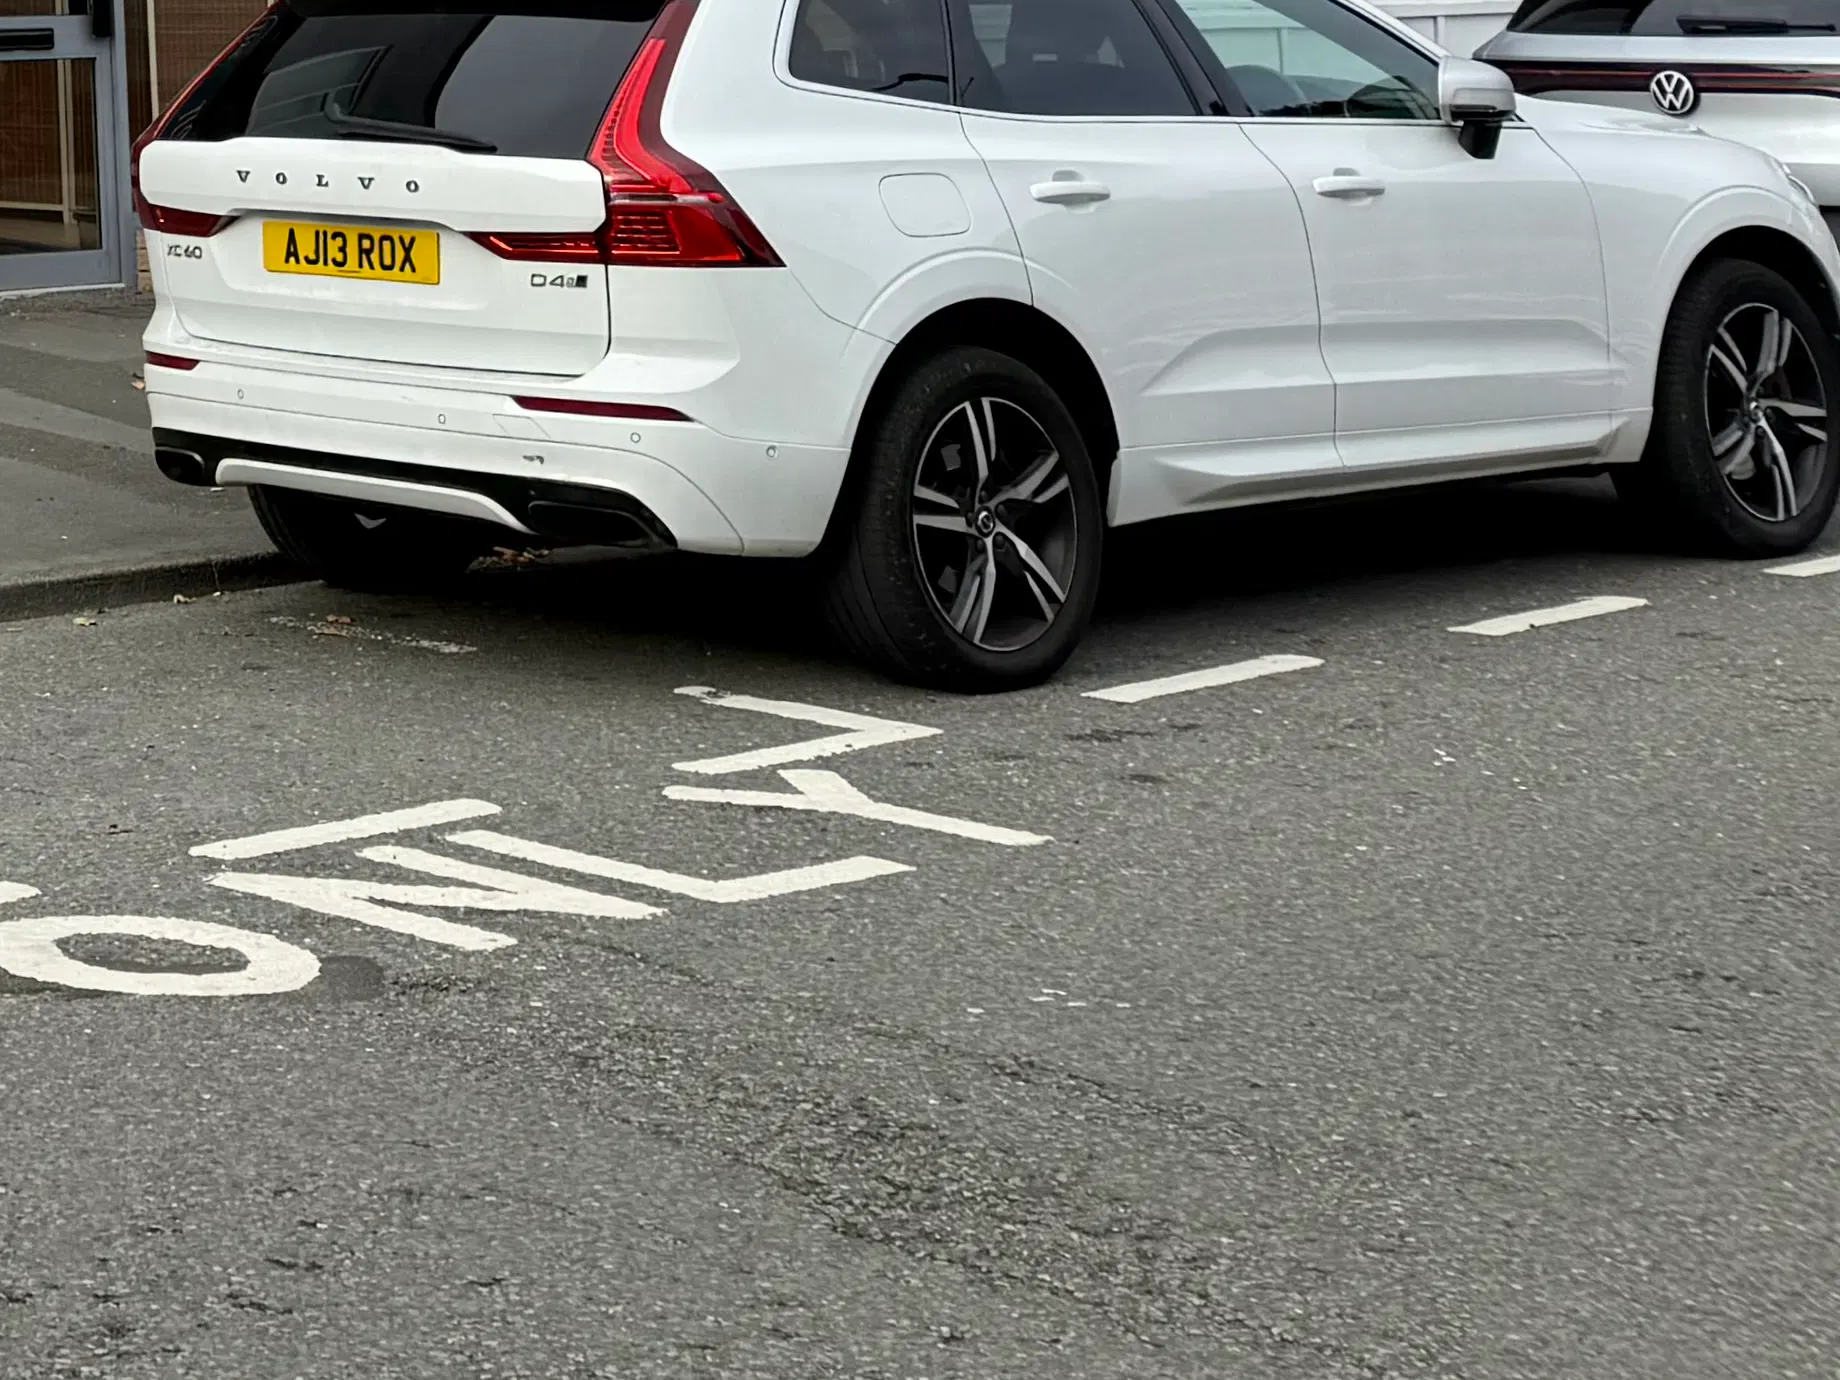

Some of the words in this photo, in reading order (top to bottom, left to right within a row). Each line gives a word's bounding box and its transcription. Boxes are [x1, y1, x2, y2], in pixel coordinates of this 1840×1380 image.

[236, 169, 420, 194] VOLVO
[284, 227, 349, 269] AJ13
[357, 233, 417, 274] ROX
[530, 273, 565, 289] D4
